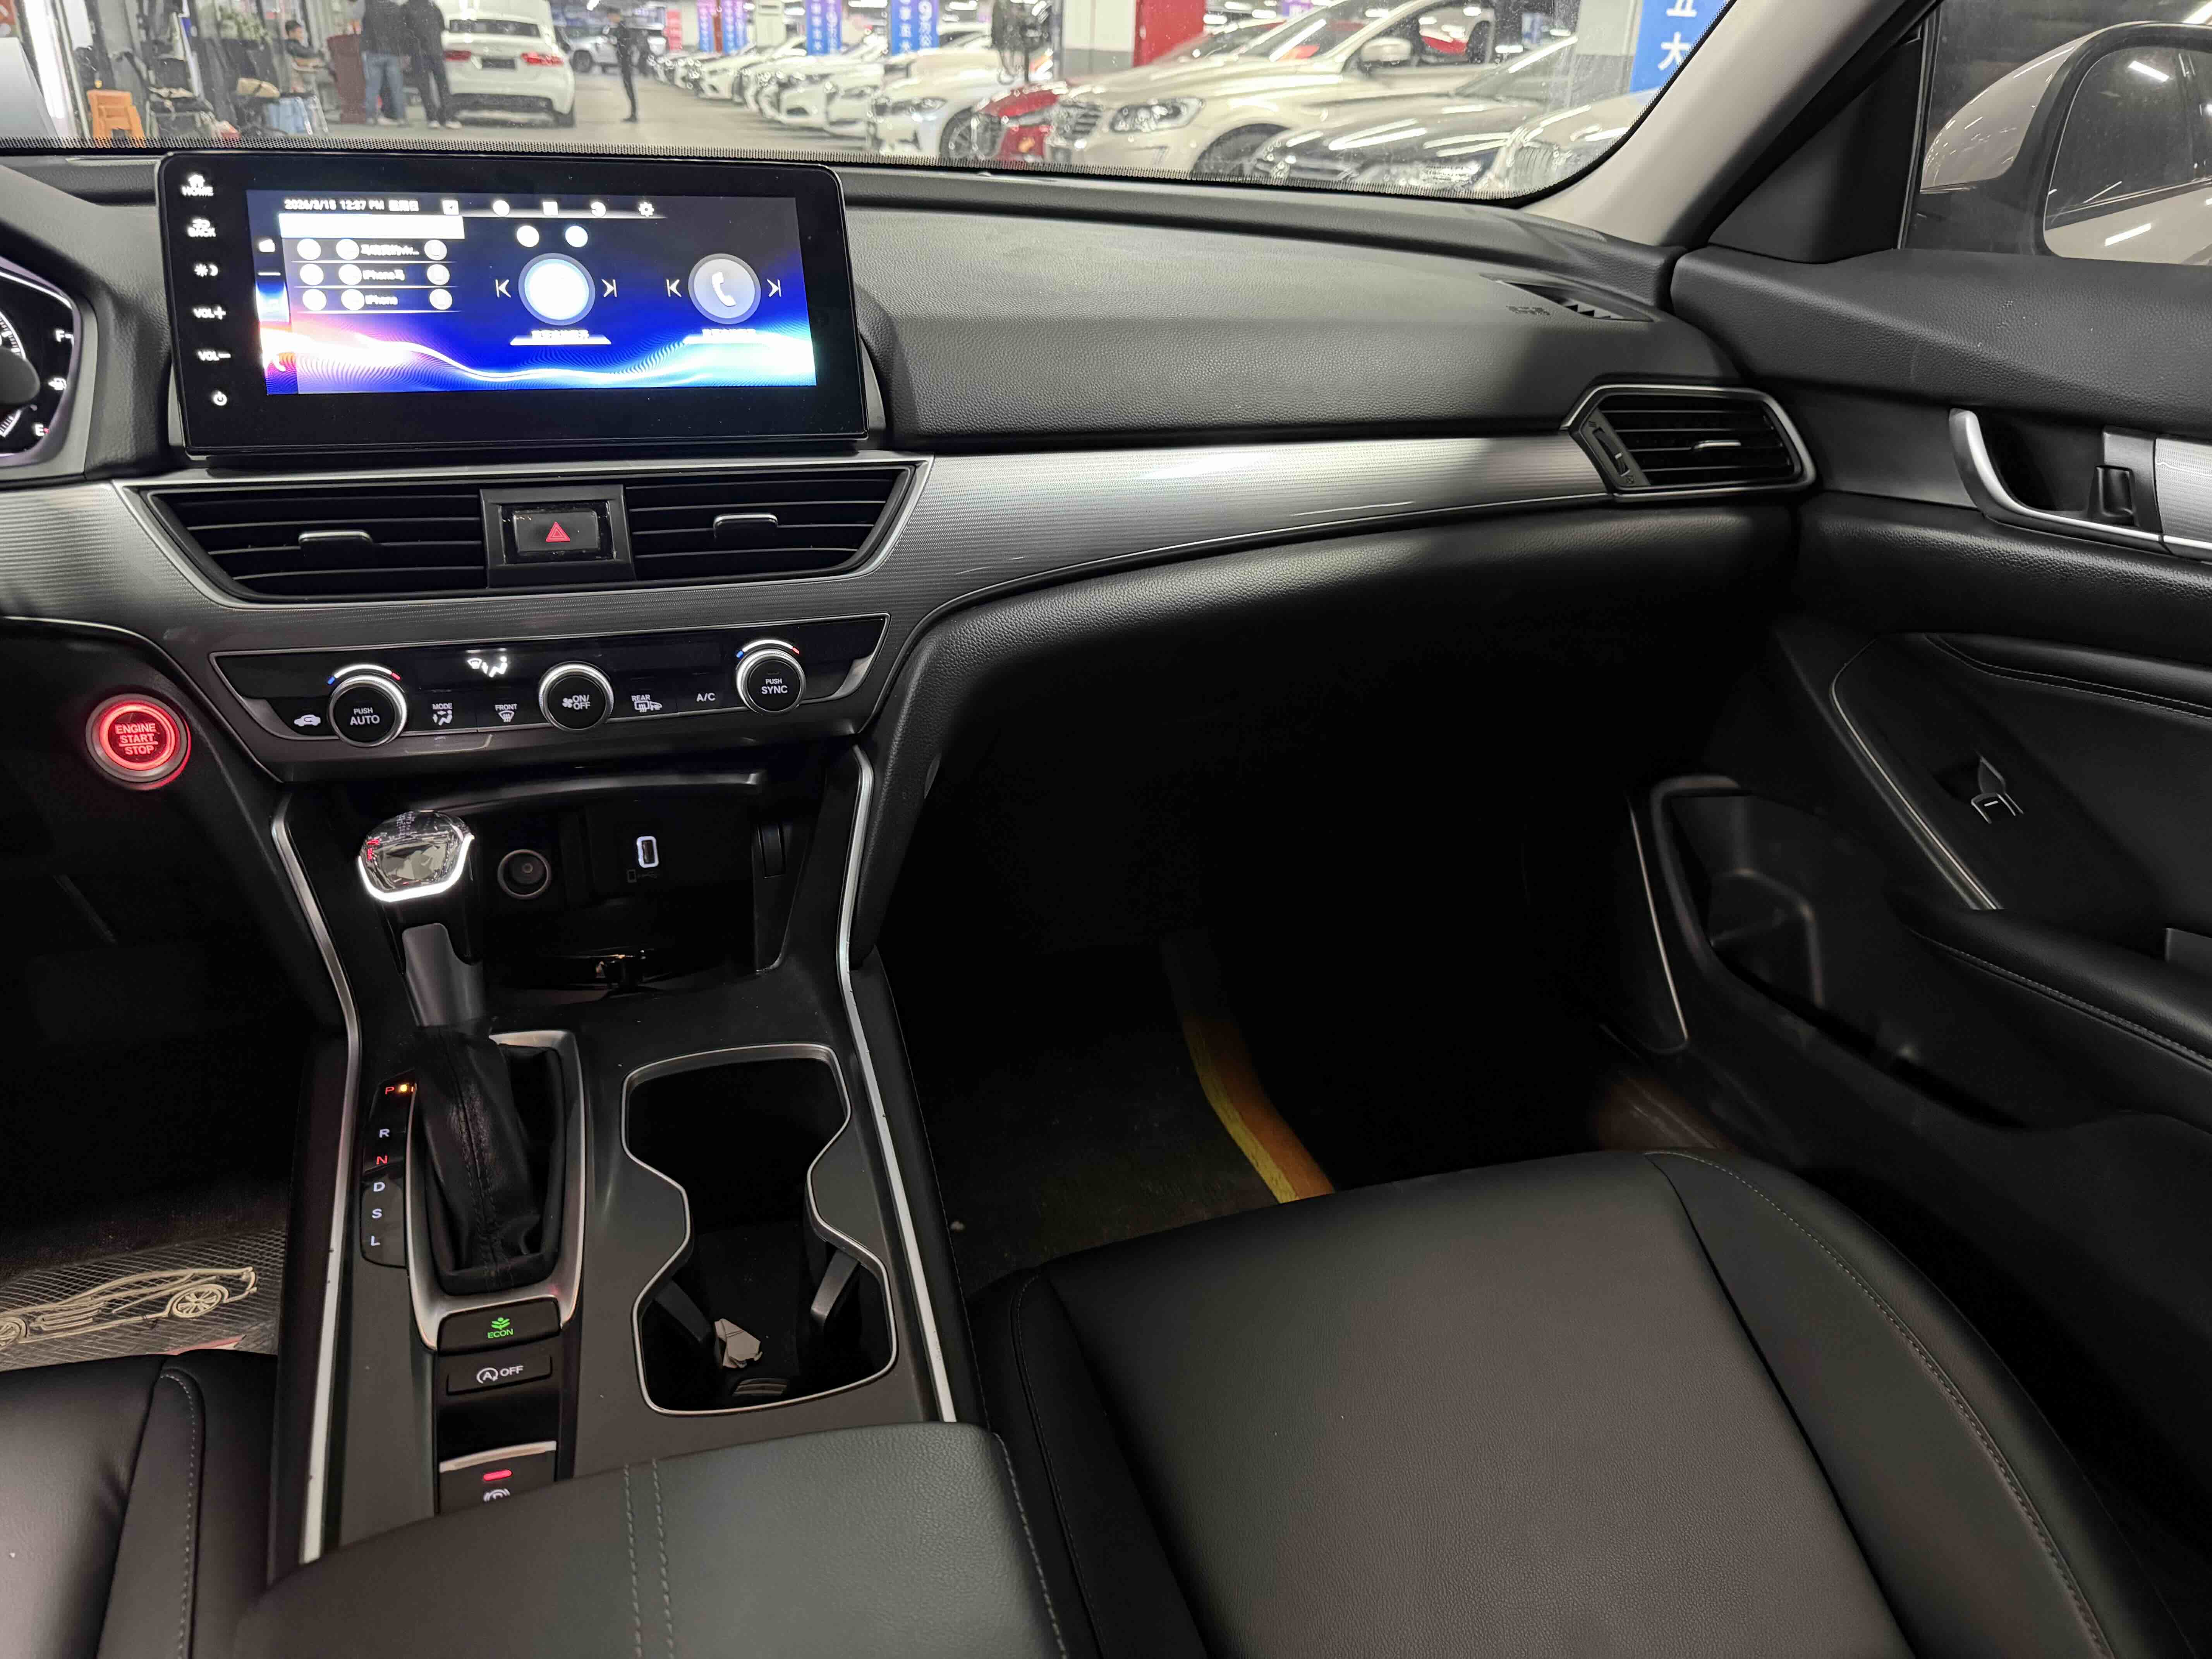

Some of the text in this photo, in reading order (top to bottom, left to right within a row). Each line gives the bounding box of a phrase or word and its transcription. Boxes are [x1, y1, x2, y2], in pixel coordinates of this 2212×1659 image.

[181, 185, 214, 196] HOME
[369, 200, 385, 210] PM
[187, 226, 216, 237] BACK
[55, 330, 64, 342] F
[35, 424, 45, 436] E
[761, 685, 788, 694] SYNC
[697, 692, 716, 702] A/C
[353, 707, 373, 715] PUSH
[573, 702, 591, 710] OFF
[350, 714, 380, 725] AUTO
[115, 722, 156, 734] ENGINE
[120, 734, 155, 744] START
[125, 745, 155, 755] STOP
[385, 1087, 395, 1095] P
[379, 1128, 390, 1138] R
[376, 1155, 388, 1165] N
[373, 1182, 385, 1192] D
[371, 1208, 382, 1219] S
[371, 1236, 380, 1246] L
[487, 1329, 514, 1339] ECON
[500, 1365, 524, 1377] OFF
